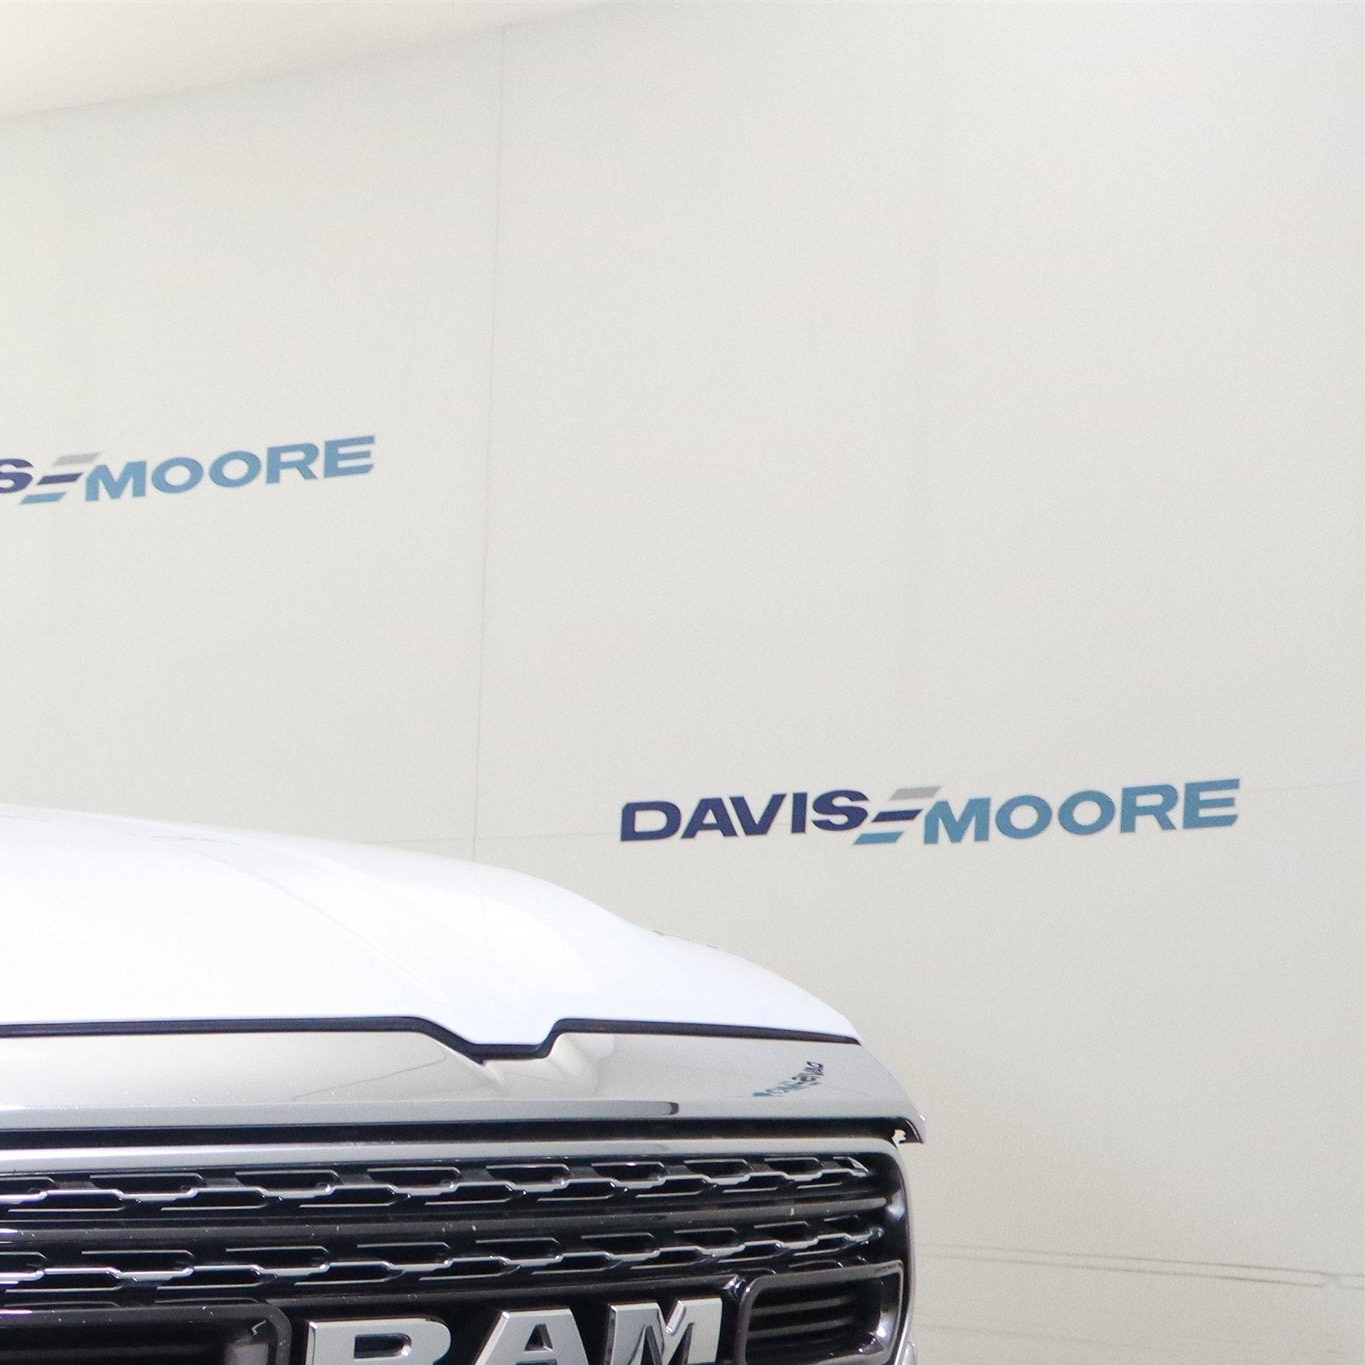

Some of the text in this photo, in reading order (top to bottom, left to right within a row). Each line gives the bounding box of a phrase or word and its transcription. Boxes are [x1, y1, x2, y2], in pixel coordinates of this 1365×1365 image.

[85, 435, 376, 503] MOORE
[619, 778, 1241, 845] DAVIS MOORE
